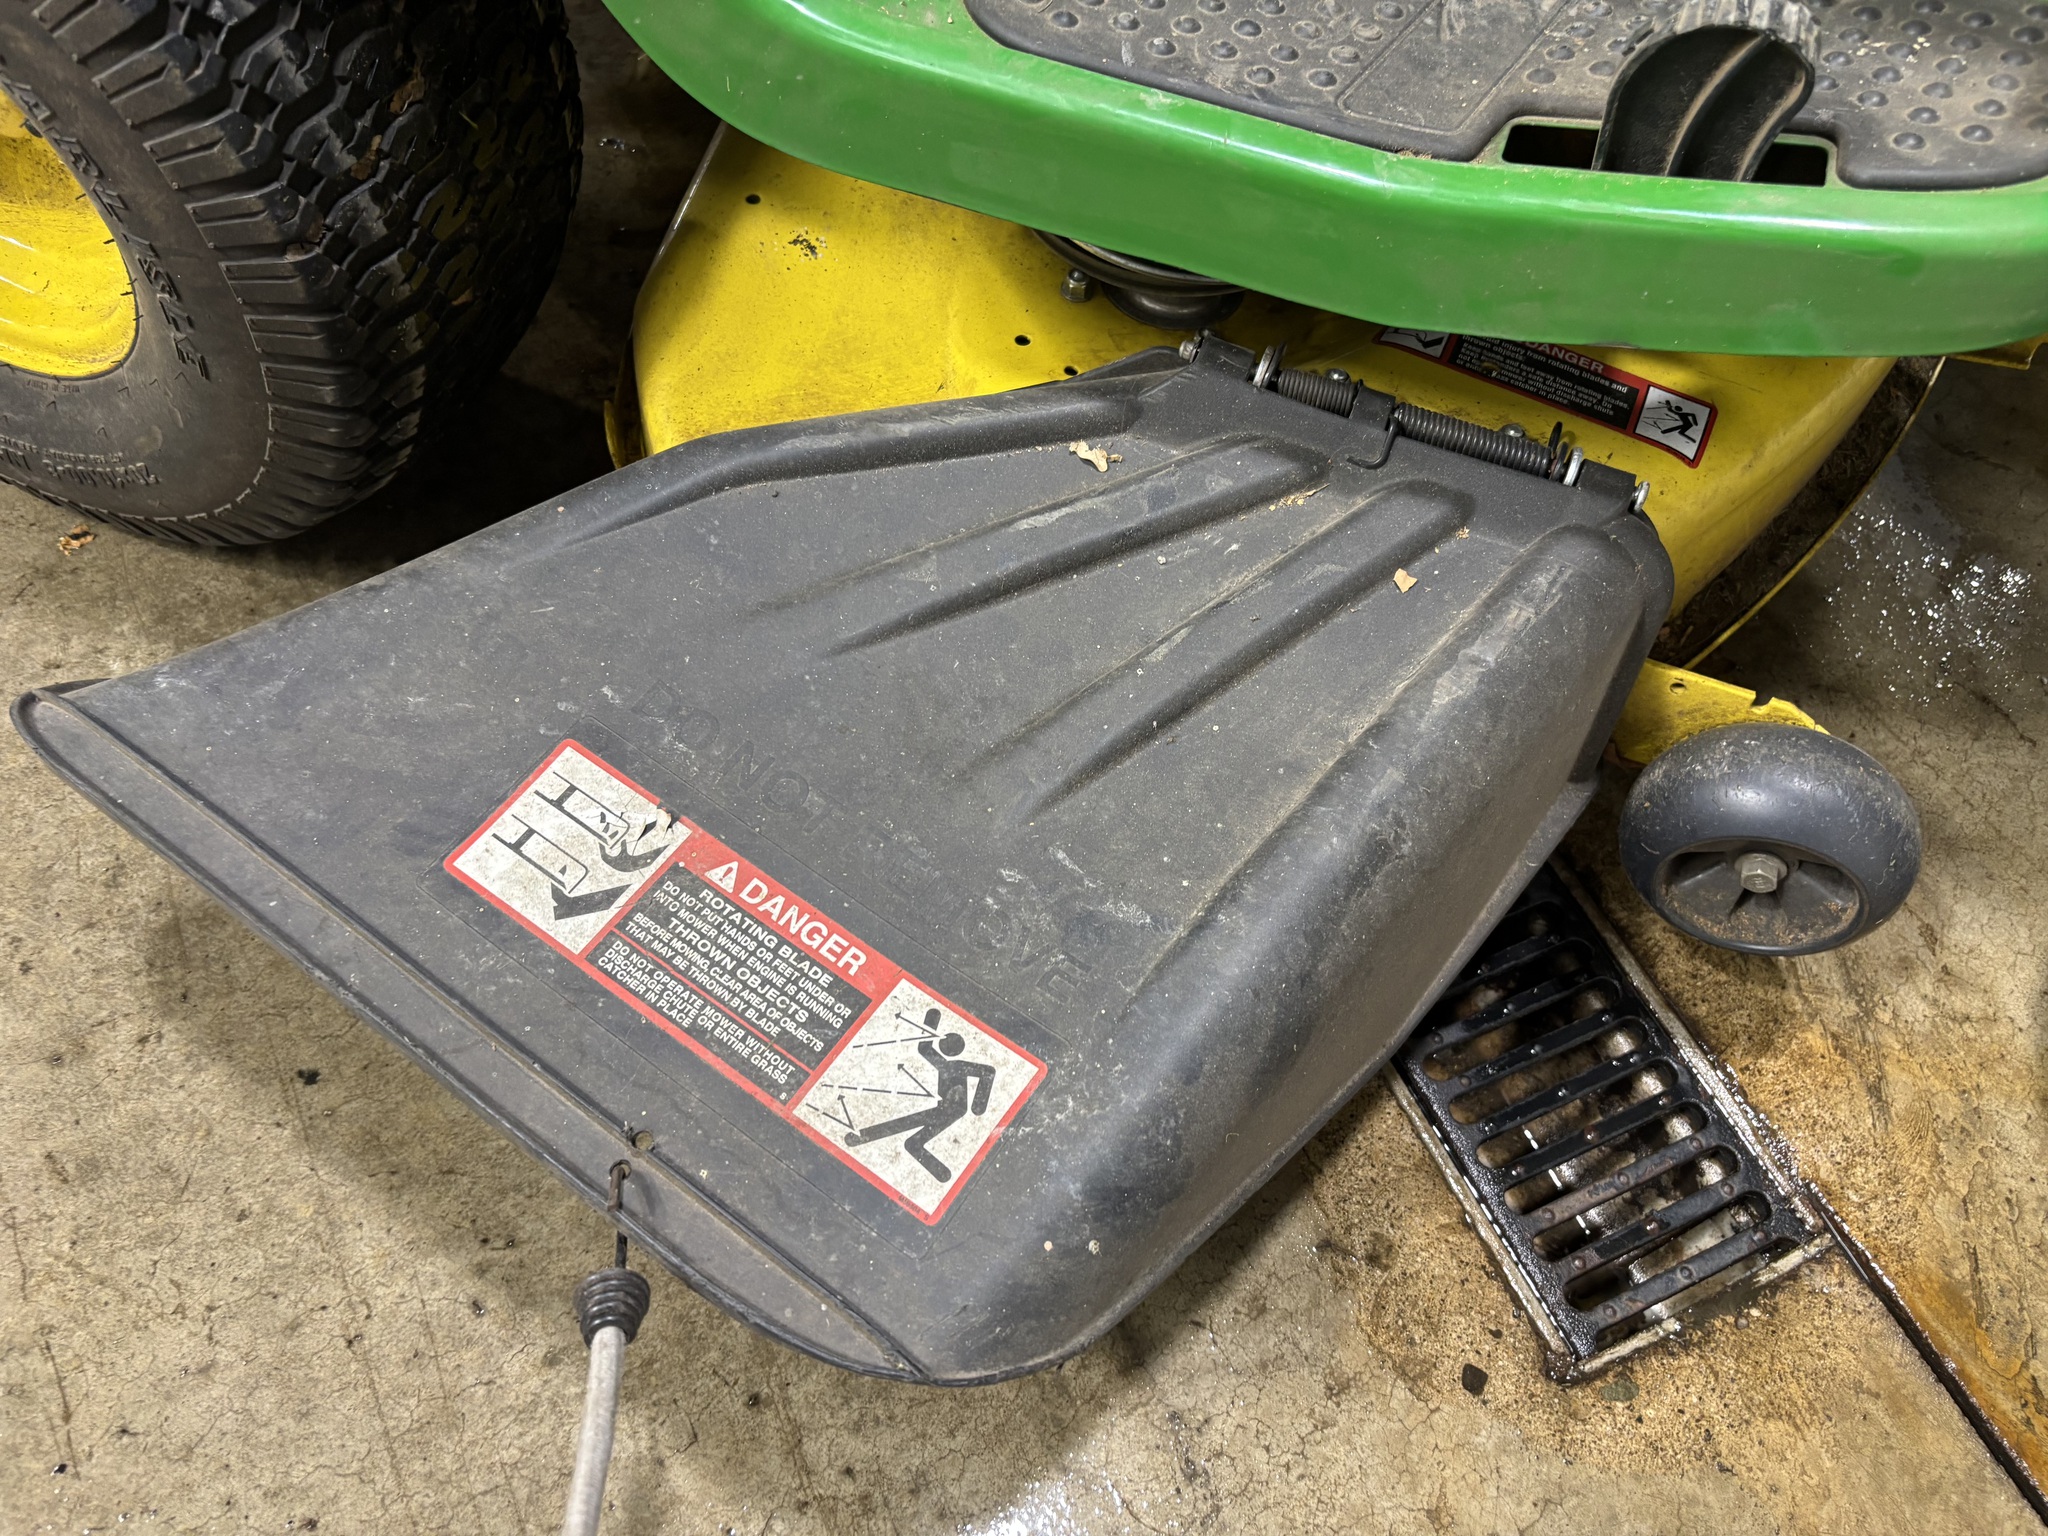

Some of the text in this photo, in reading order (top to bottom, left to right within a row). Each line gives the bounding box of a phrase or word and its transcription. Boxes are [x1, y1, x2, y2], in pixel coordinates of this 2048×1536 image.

[1546, 358, 1580, 376] rotating
[1581, 370, 1610, 386] blades
[1610, 382, 1627, 393] and
[632, 680, 721, 749] DO
[720, 739, 846, 837] NOT
[624, 921, 780, 1036] THAT MAY BE THROWN BY BLADE
[633, 912, 824, 1051] BEFORE MOWING, CLEAR AREA OF OBJECTS
[653, 890, 843, 1028] INTO MOWER WHEN ENGINE IS RUNNING
[662, 881, 851, 1018] DO NOT PUT HANDS OR FEET UNDER OR
[666, 917, 809, 1022] THROWN OBJECTS
[698, 889, 833, 987] ROTATING BLADE
[738, 877, 869, 975] DANGER
[597, 956, 692, 1027] CATCHER IN PLACE
[604, 948, 788, 1084] DISCHARGE CHUTE OR ENTIRE GRASS
[612, 941, 794, 1075] DO NOT OPERATE MOWER WITHOUT
